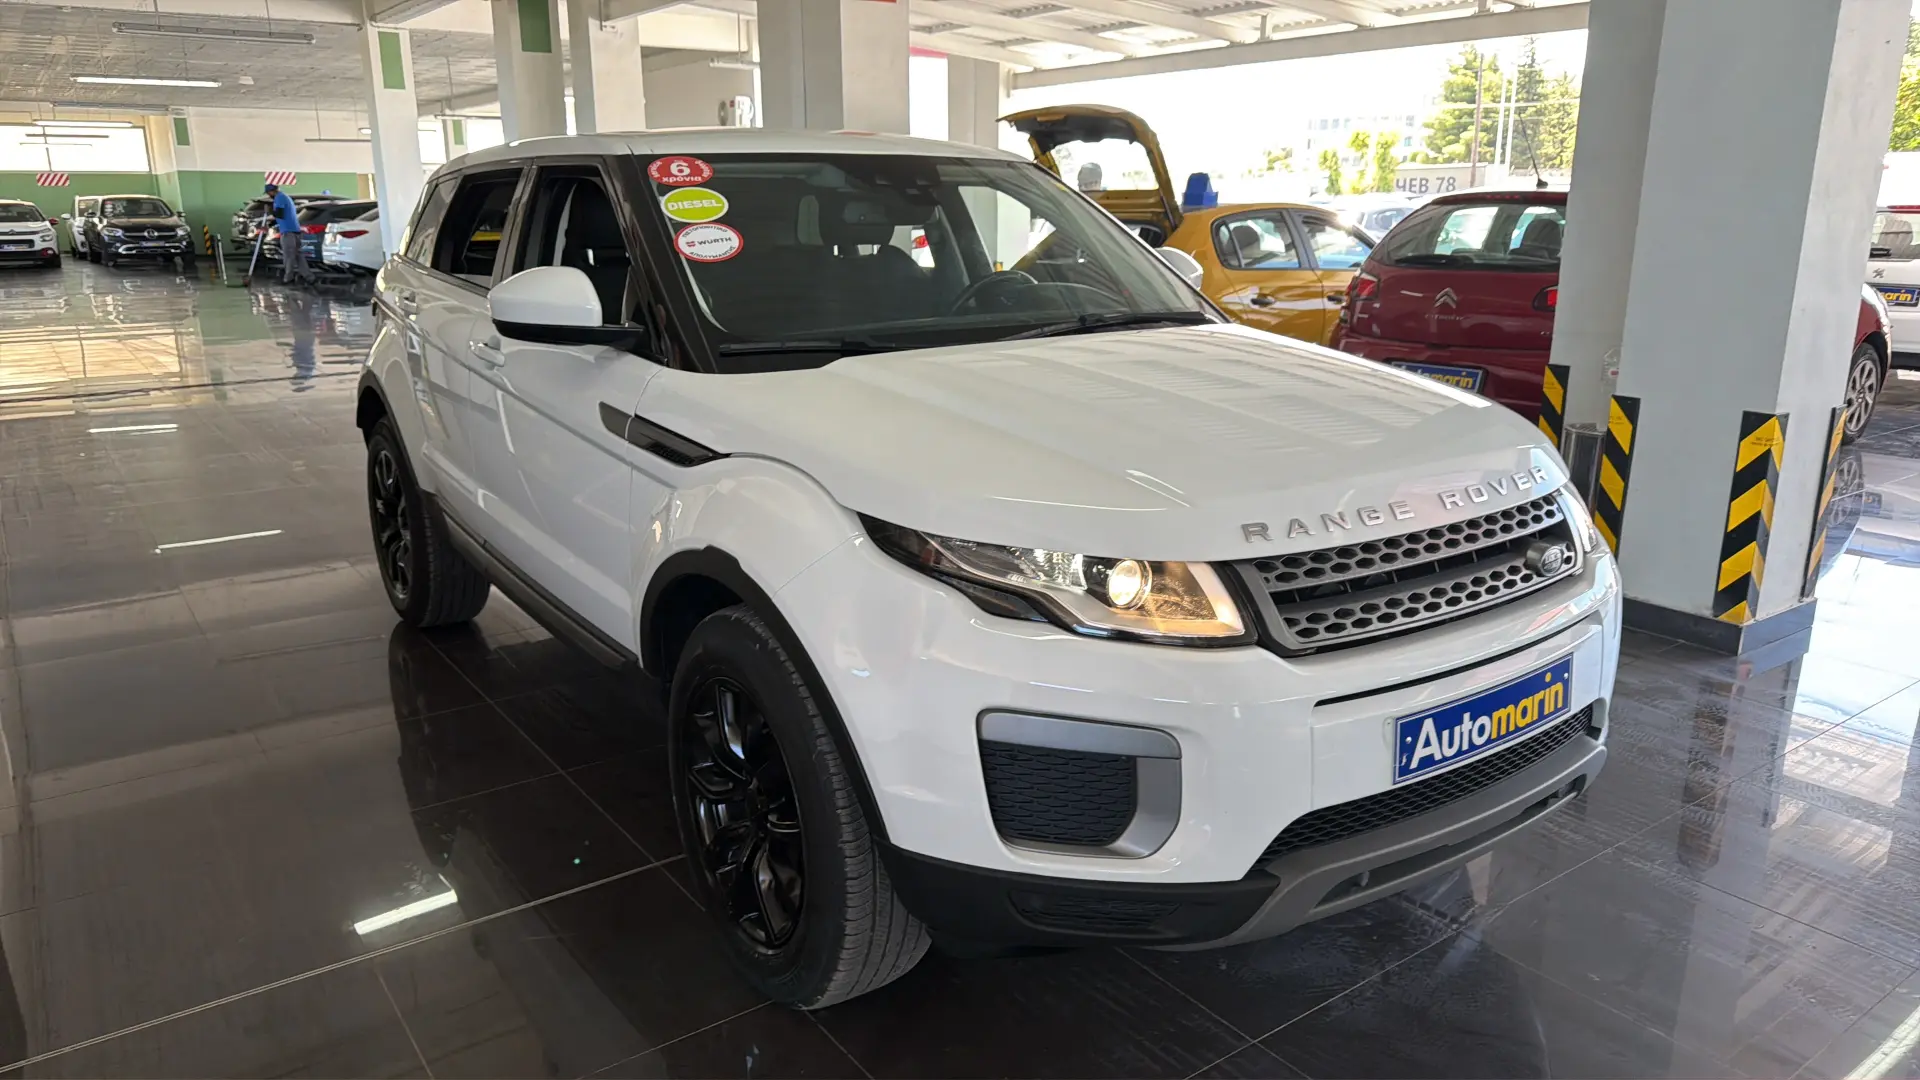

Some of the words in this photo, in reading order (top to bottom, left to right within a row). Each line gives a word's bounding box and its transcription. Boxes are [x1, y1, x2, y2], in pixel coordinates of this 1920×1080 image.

[670, 162, 690, 176] 6
[1436, 176, 1456, 193] 78
[668, 200, 722, 210] DIESEL
[1241, 500, 1415, 543] RANGE
[1439, 466, 1549, 510] ROVER
[1409, 672, 1563, 769] Automarin
